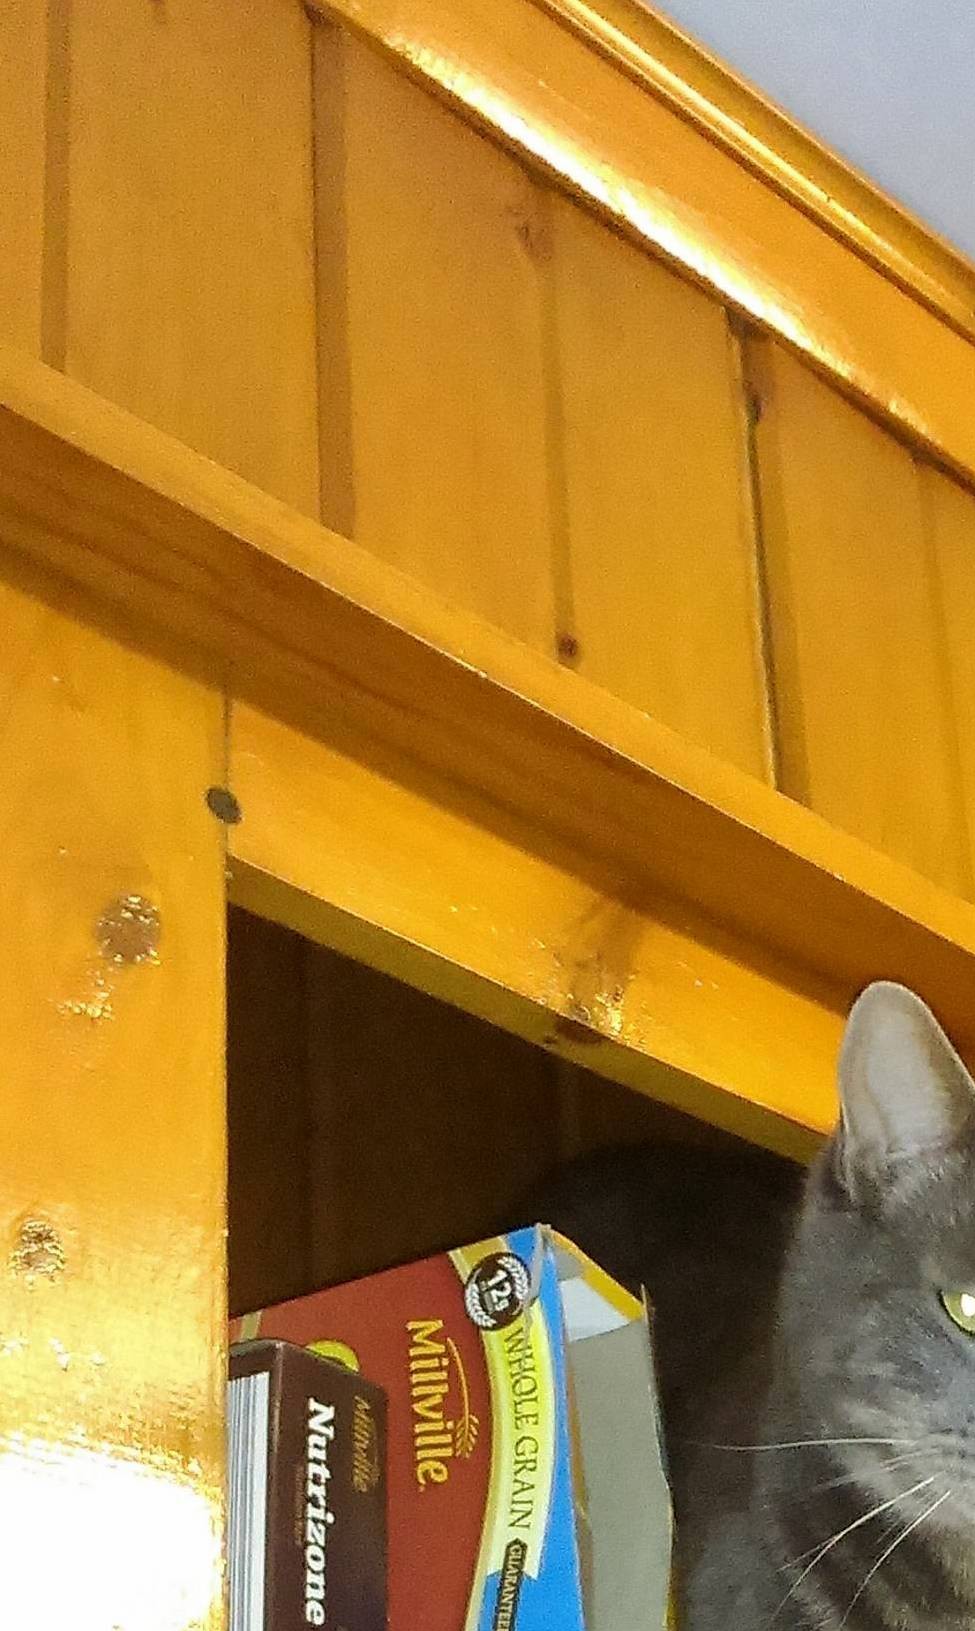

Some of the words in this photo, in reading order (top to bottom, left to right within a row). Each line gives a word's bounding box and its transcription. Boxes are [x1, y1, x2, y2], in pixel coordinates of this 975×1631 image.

[405, 1318, 454, 1486] Millville
[503, 1327, 539, 1430] WHOLE
[305, 1396, 335, 1626] Nutrizone
[507, 1434, 540, 1530] GRAIN
